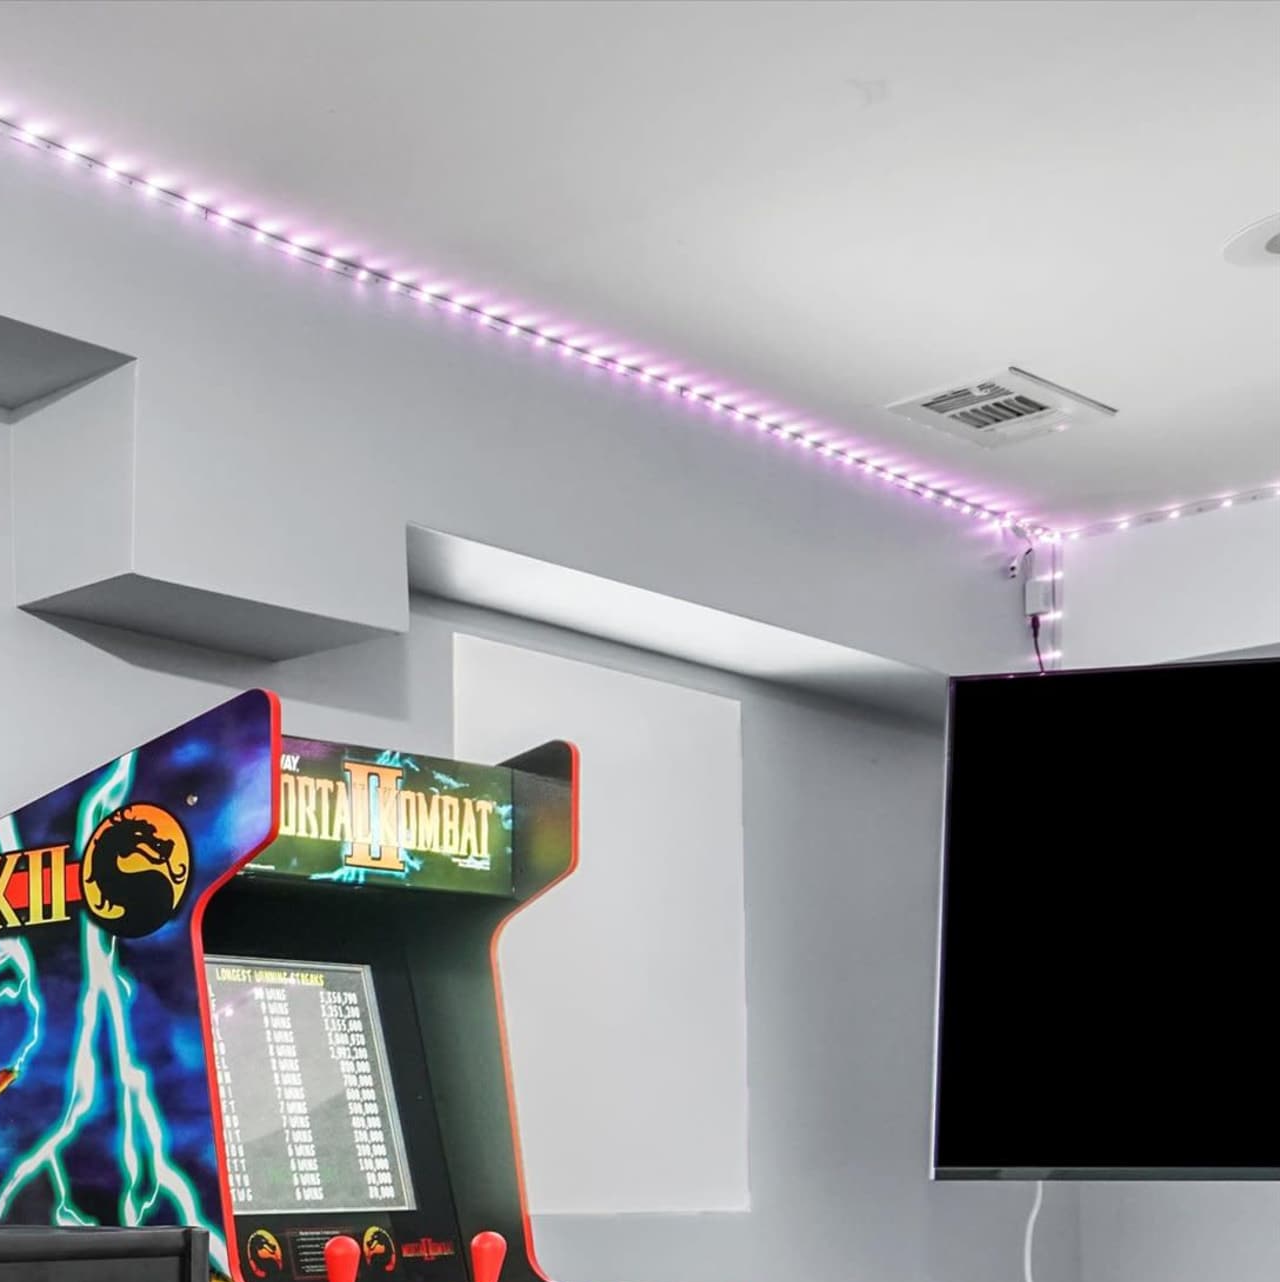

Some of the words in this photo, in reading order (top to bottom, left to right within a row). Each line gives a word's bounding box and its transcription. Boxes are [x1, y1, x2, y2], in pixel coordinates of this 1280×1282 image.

[280, 773, 372, 845] ORTAL
[377, 783, 493, 858] KOMBAT
[216, 967, 252, 984] LONGEST
